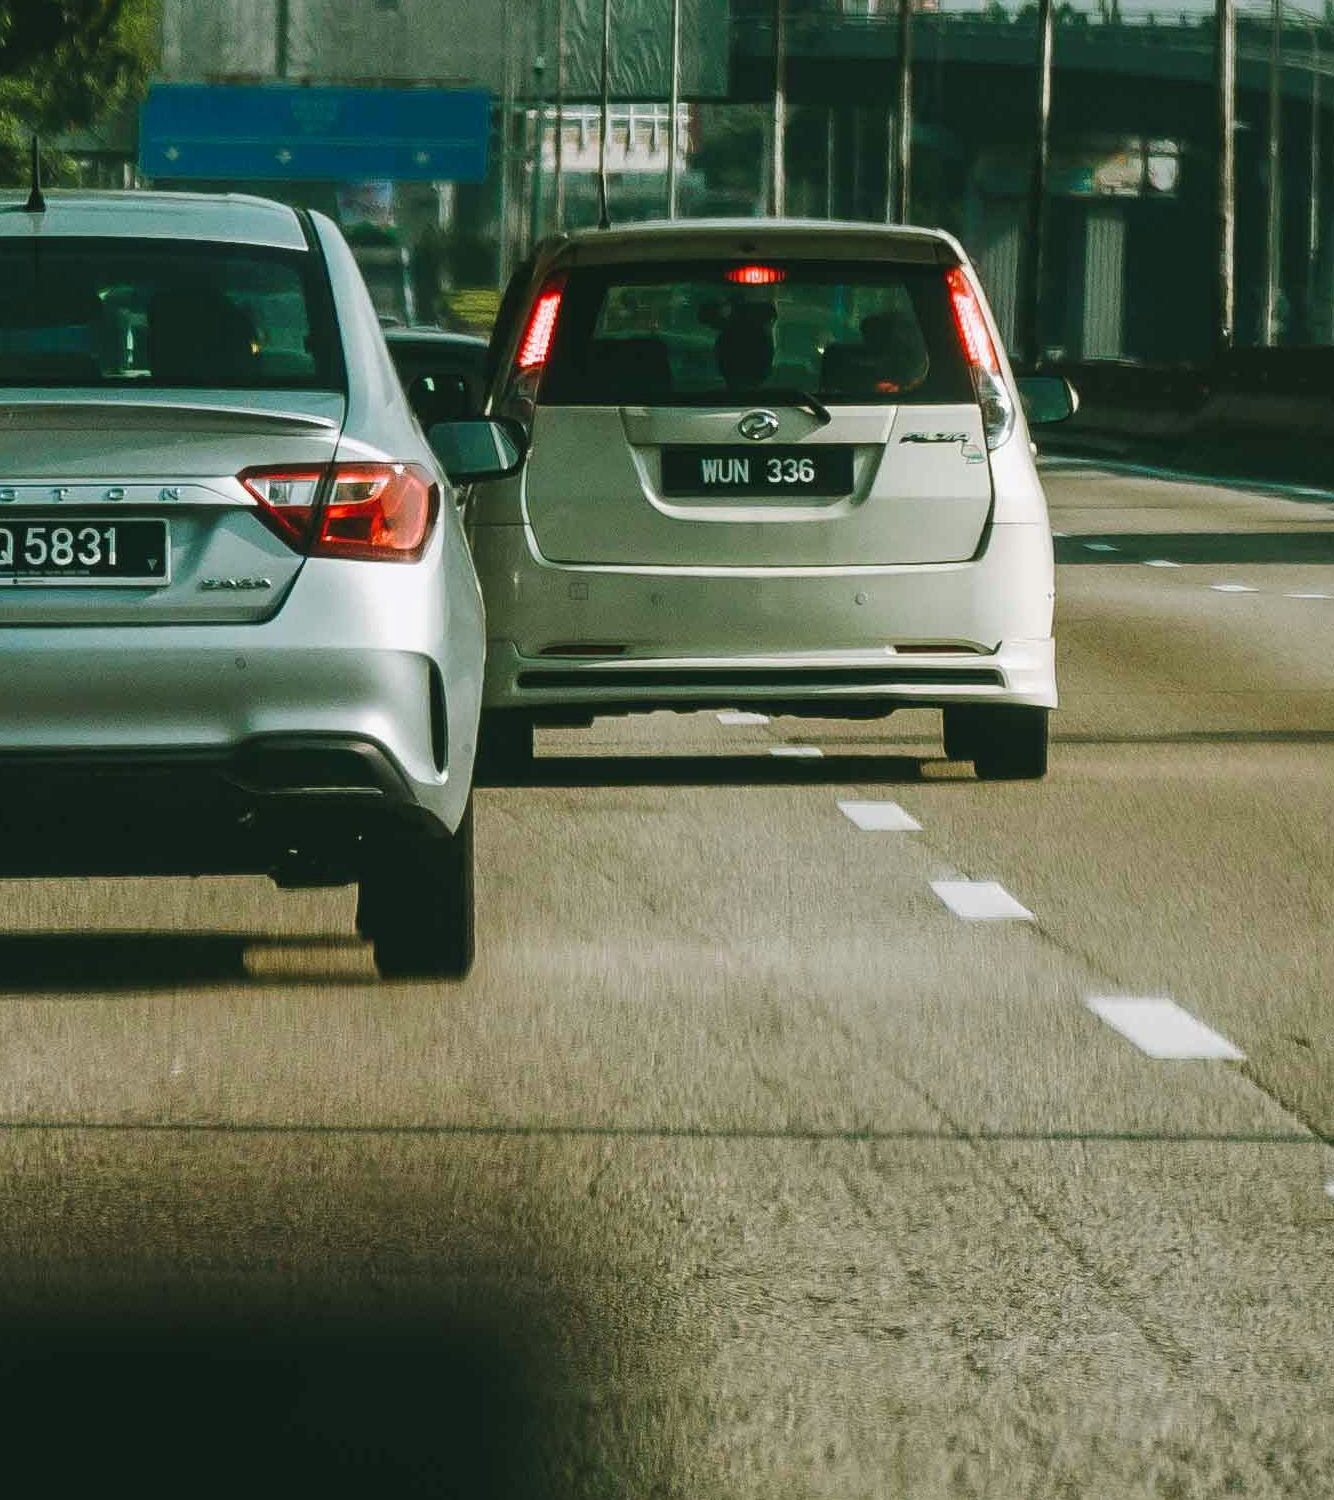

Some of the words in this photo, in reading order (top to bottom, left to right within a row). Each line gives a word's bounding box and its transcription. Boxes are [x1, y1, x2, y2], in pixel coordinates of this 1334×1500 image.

[701, 458, 749, 483] WUN
[767, 458, 815, 483] 336
[24, 526, 117, 566] 5831
